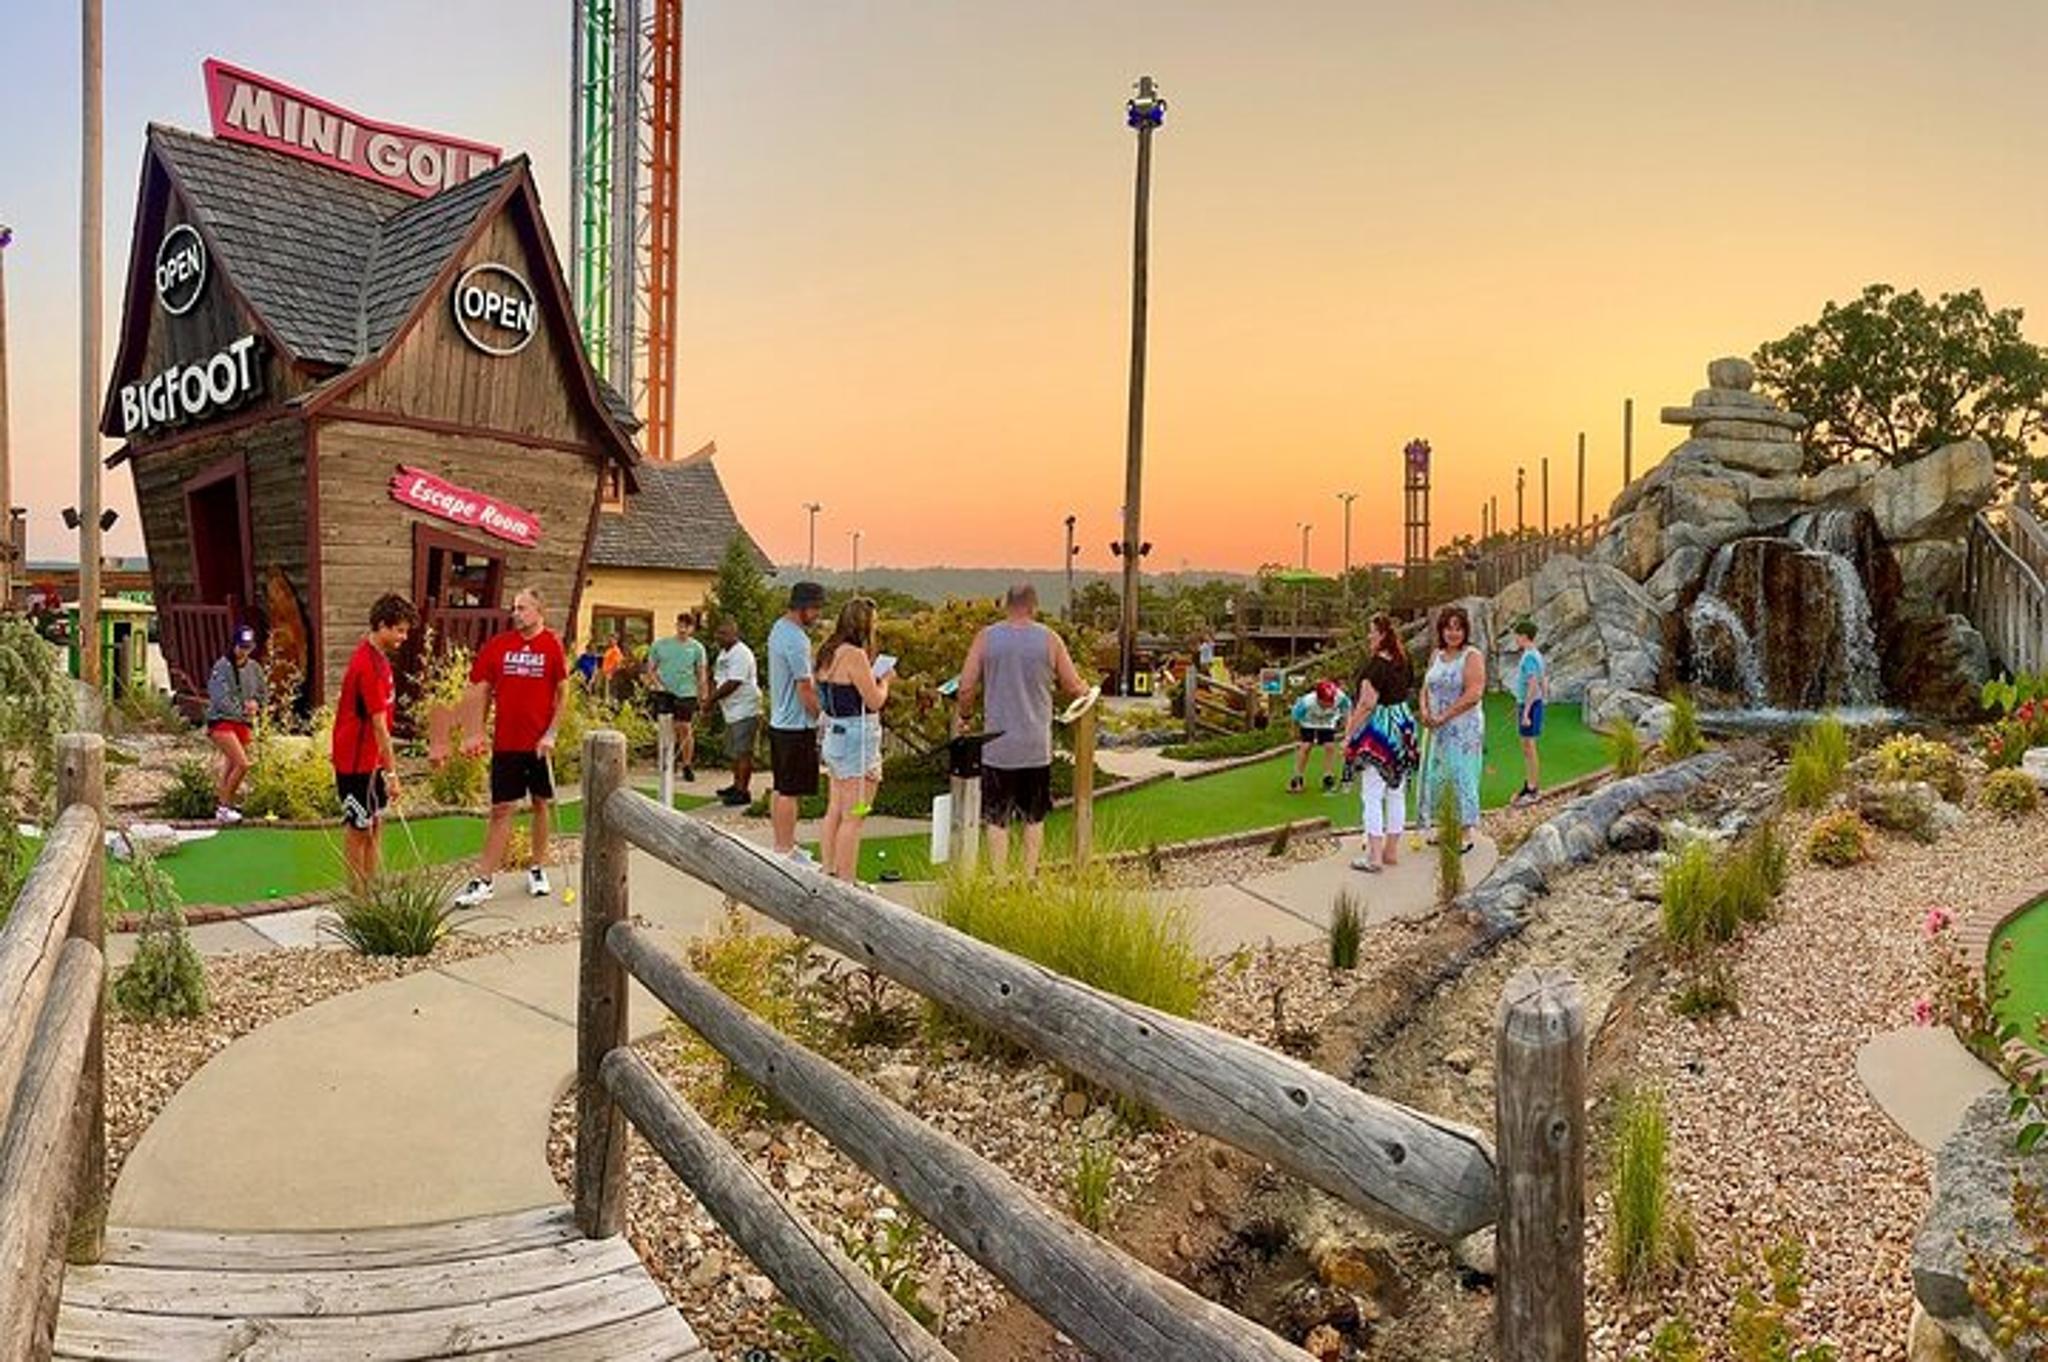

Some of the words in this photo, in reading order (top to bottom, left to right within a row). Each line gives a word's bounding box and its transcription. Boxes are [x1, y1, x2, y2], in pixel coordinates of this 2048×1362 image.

[225, 83, 357, 161] MINI
[156, 244, 200, 293] OPEN
[464, 287, 535, 331] OPEN
[121, 335, 254, 433] BIGFOOT
[410, 478, 477, 517] Escape
[480, 504, 529, 537] Room
